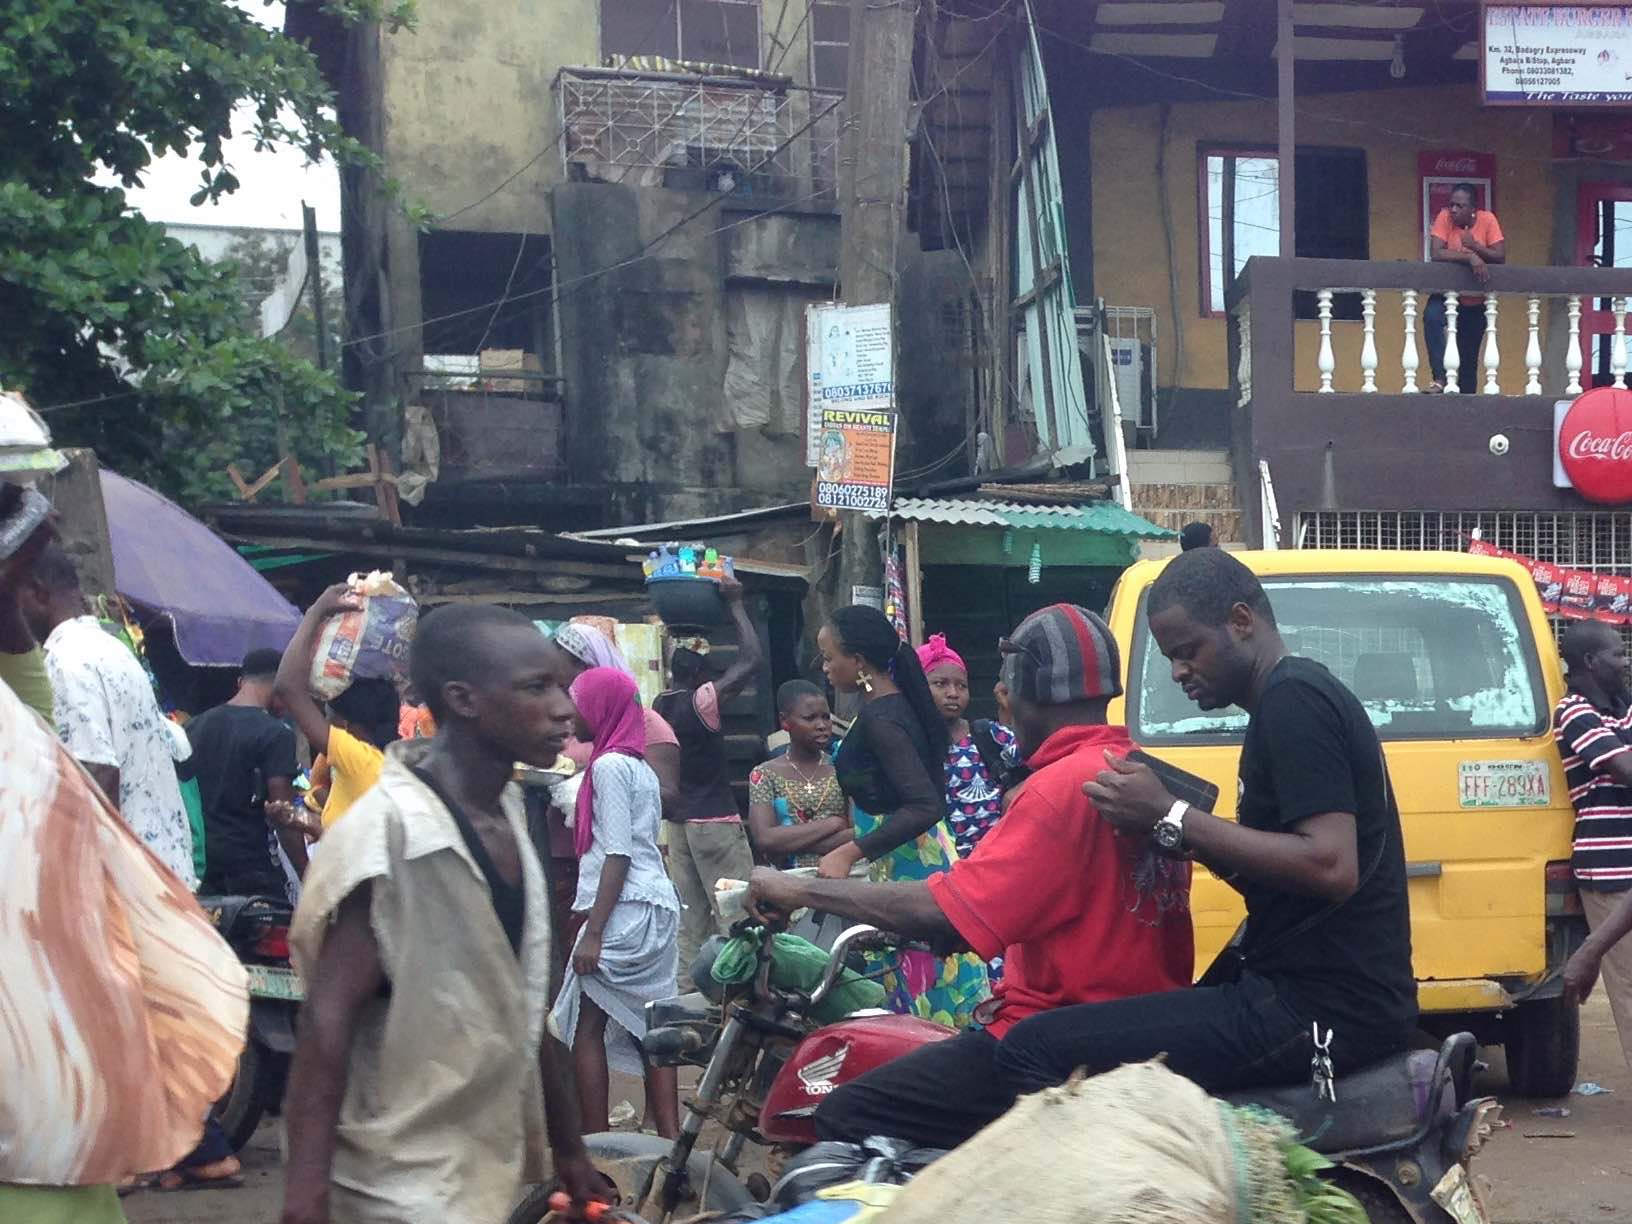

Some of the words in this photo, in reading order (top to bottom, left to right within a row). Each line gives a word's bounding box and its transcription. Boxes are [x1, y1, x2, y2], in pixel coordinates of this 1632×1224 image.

[1526, 91, 1555, 101] The
[1561, 91, 1600, 101] Taste
[1605, 92, 1632, 102] you
[824, 410, 890, 426] REVIVAL
[818, 482, 888, 498] 08060275189
[818, 493, 887, 508] 08121002726
